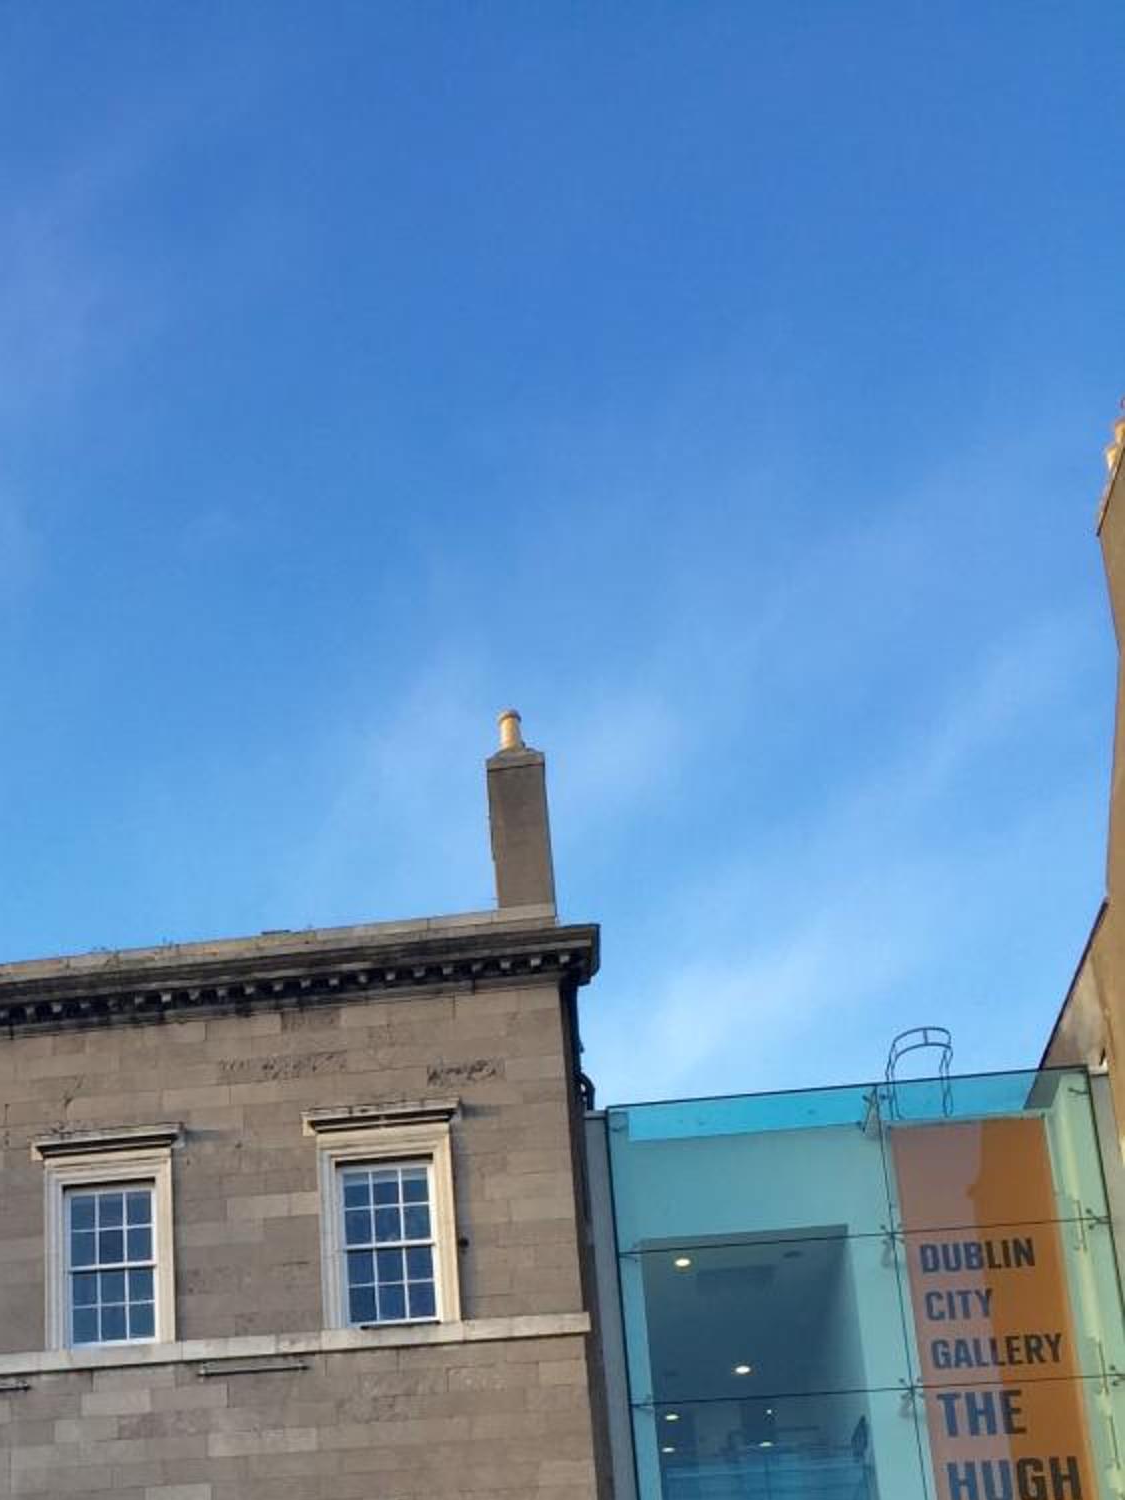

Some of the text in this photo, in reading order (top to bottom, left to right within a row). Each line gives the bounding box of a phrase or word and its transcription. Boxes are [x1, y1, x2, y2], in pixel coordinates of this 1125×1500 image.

[919, 1237, 1036, 1274] DUBLIN
[925, 1288, 993, 1321] CITY
[931, 1333, 1062, 1370] GALLERY
[936, 1390, 1027, 1438] THE
